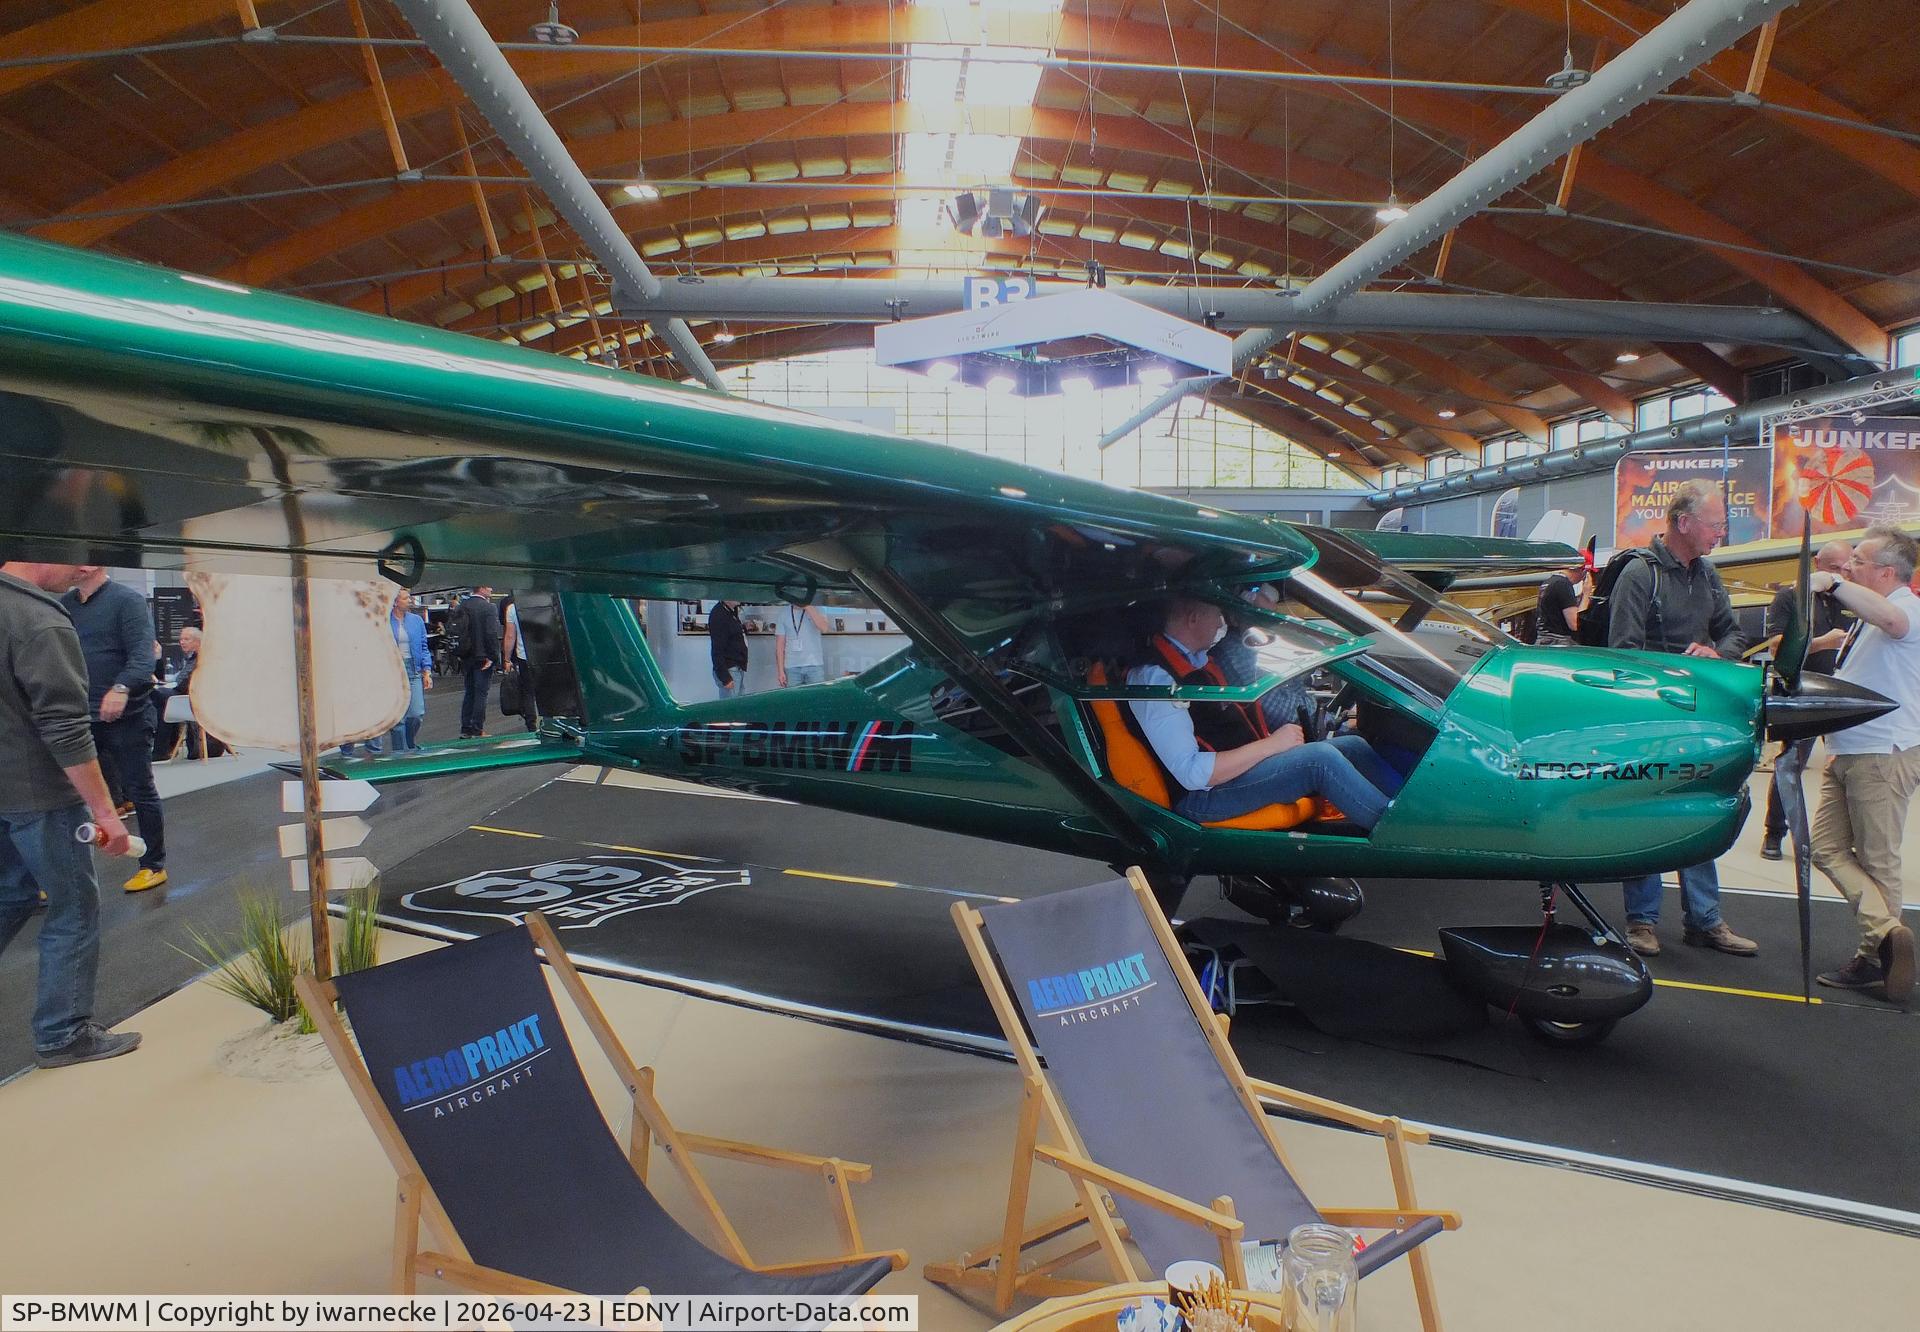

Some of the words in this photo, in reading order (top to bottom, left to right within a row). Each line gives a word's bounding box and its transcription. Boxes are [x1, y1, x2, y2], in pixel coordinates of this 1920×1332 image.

[1635, 508, 1664, 519] YOU
[1027, 952, 1151, 1012] AEROPRAKT
[1060, 996, 1142, 1027] AIRCRAFT
[393, 1013, 545, 1105] AEROPRAKT
[433, 1066, 533, 1118] AIRCRAFT
